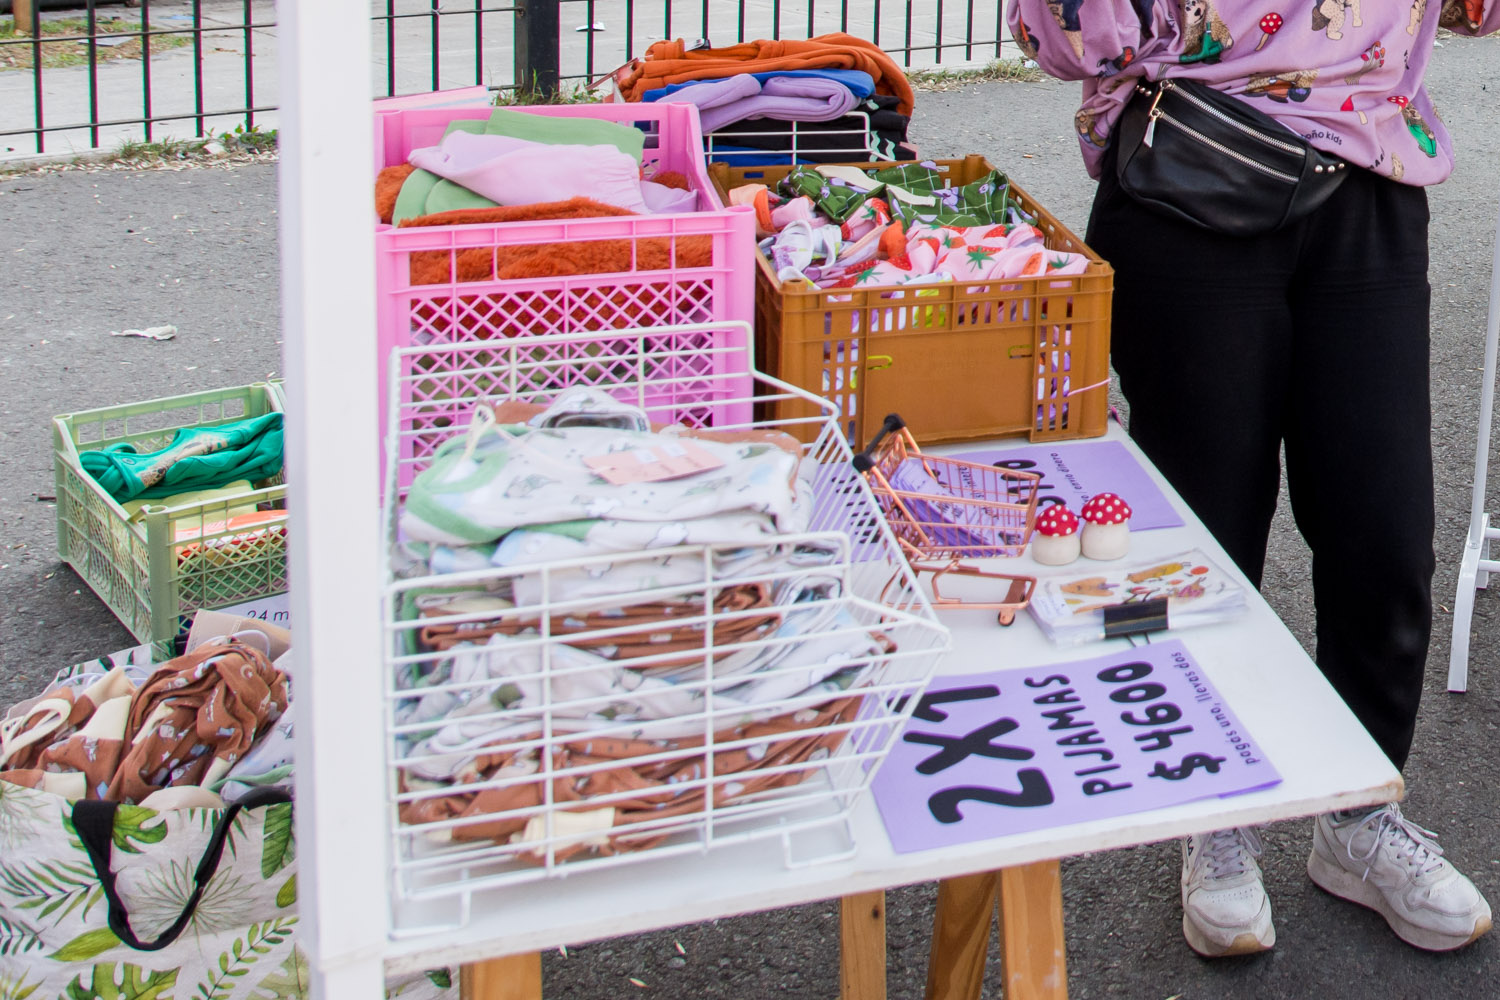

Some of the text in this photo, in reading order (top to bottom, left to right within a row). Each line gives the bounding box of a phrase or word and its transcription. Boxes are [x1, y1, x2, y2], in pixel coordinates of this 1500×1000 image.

[1325, 131, 1343, 146] kids
[1050, 453, 1070, 473] dinero
[247, 609, 268, 621] 24
[1171, 651, 1261, 765] pagás uno, llevas dos
[1024, 674, 1133, 796] PIJAMAS
